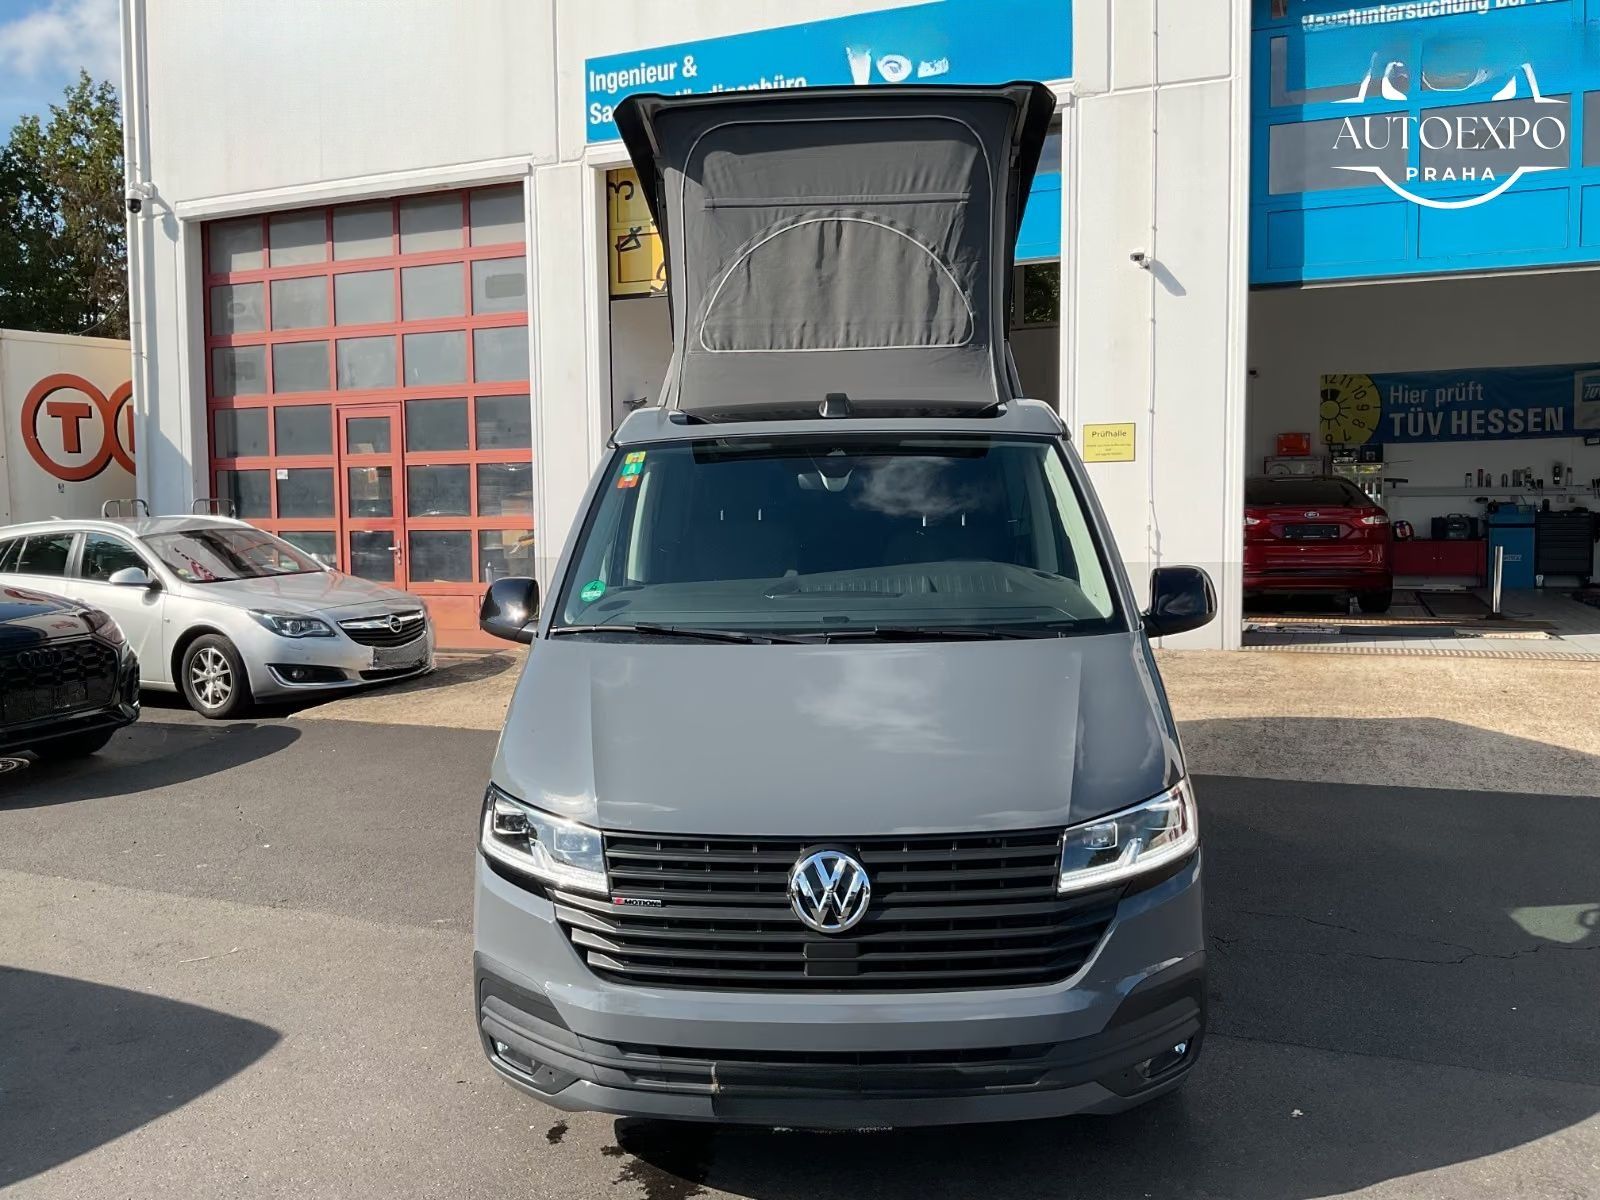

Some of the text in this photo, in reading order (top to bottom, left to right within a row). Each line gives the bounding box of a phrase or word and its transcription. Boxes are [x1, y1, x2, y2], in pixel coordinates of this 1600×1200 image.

[589, 62, 677, 93] Ingenieur
[682, 55, 698, 77] &
[1351, 385, 1367, 400] 10
[1389, 381, 1484, 407] Hier prüft
[1091, 430, 1127, 438] Prüfhalle
[1389, 407, 1564, 437] TÜV HESSEN
